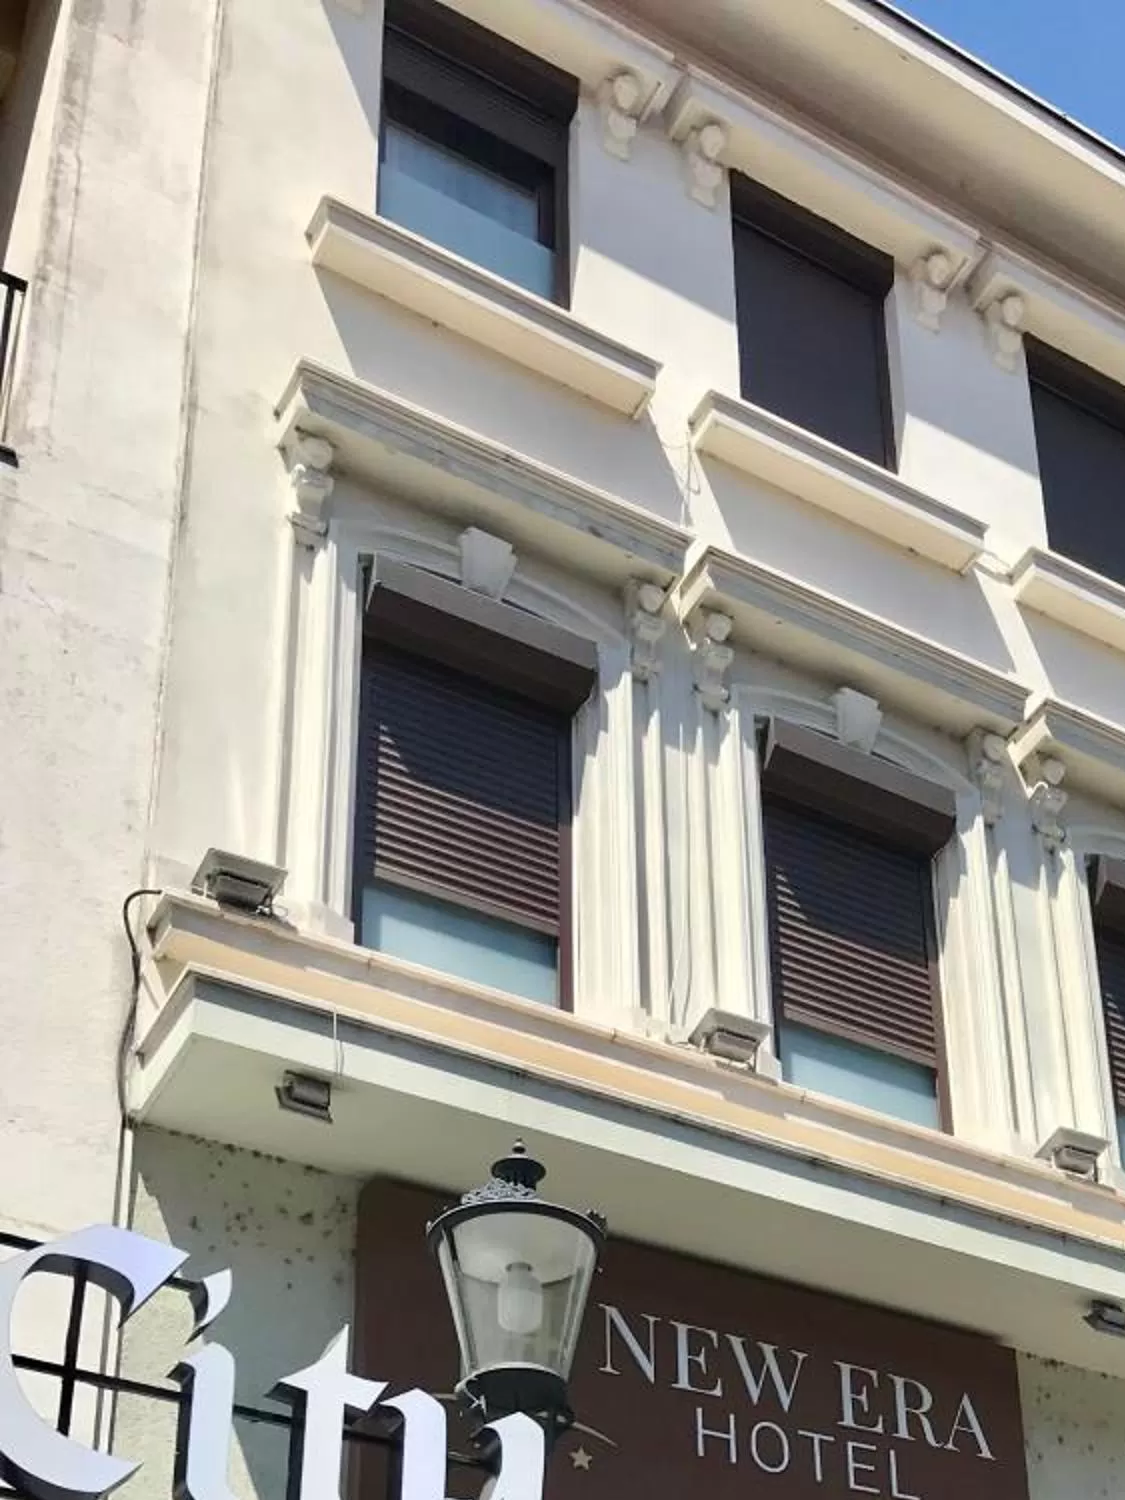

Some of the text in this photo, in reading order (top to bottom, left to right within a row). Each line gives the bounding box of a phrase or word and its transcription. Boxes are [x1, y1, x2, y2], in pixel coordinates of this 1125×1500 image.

[599, 1302, 996, 1460] NEW ERA
[695, 1407, 921, 1500] HOTEL
